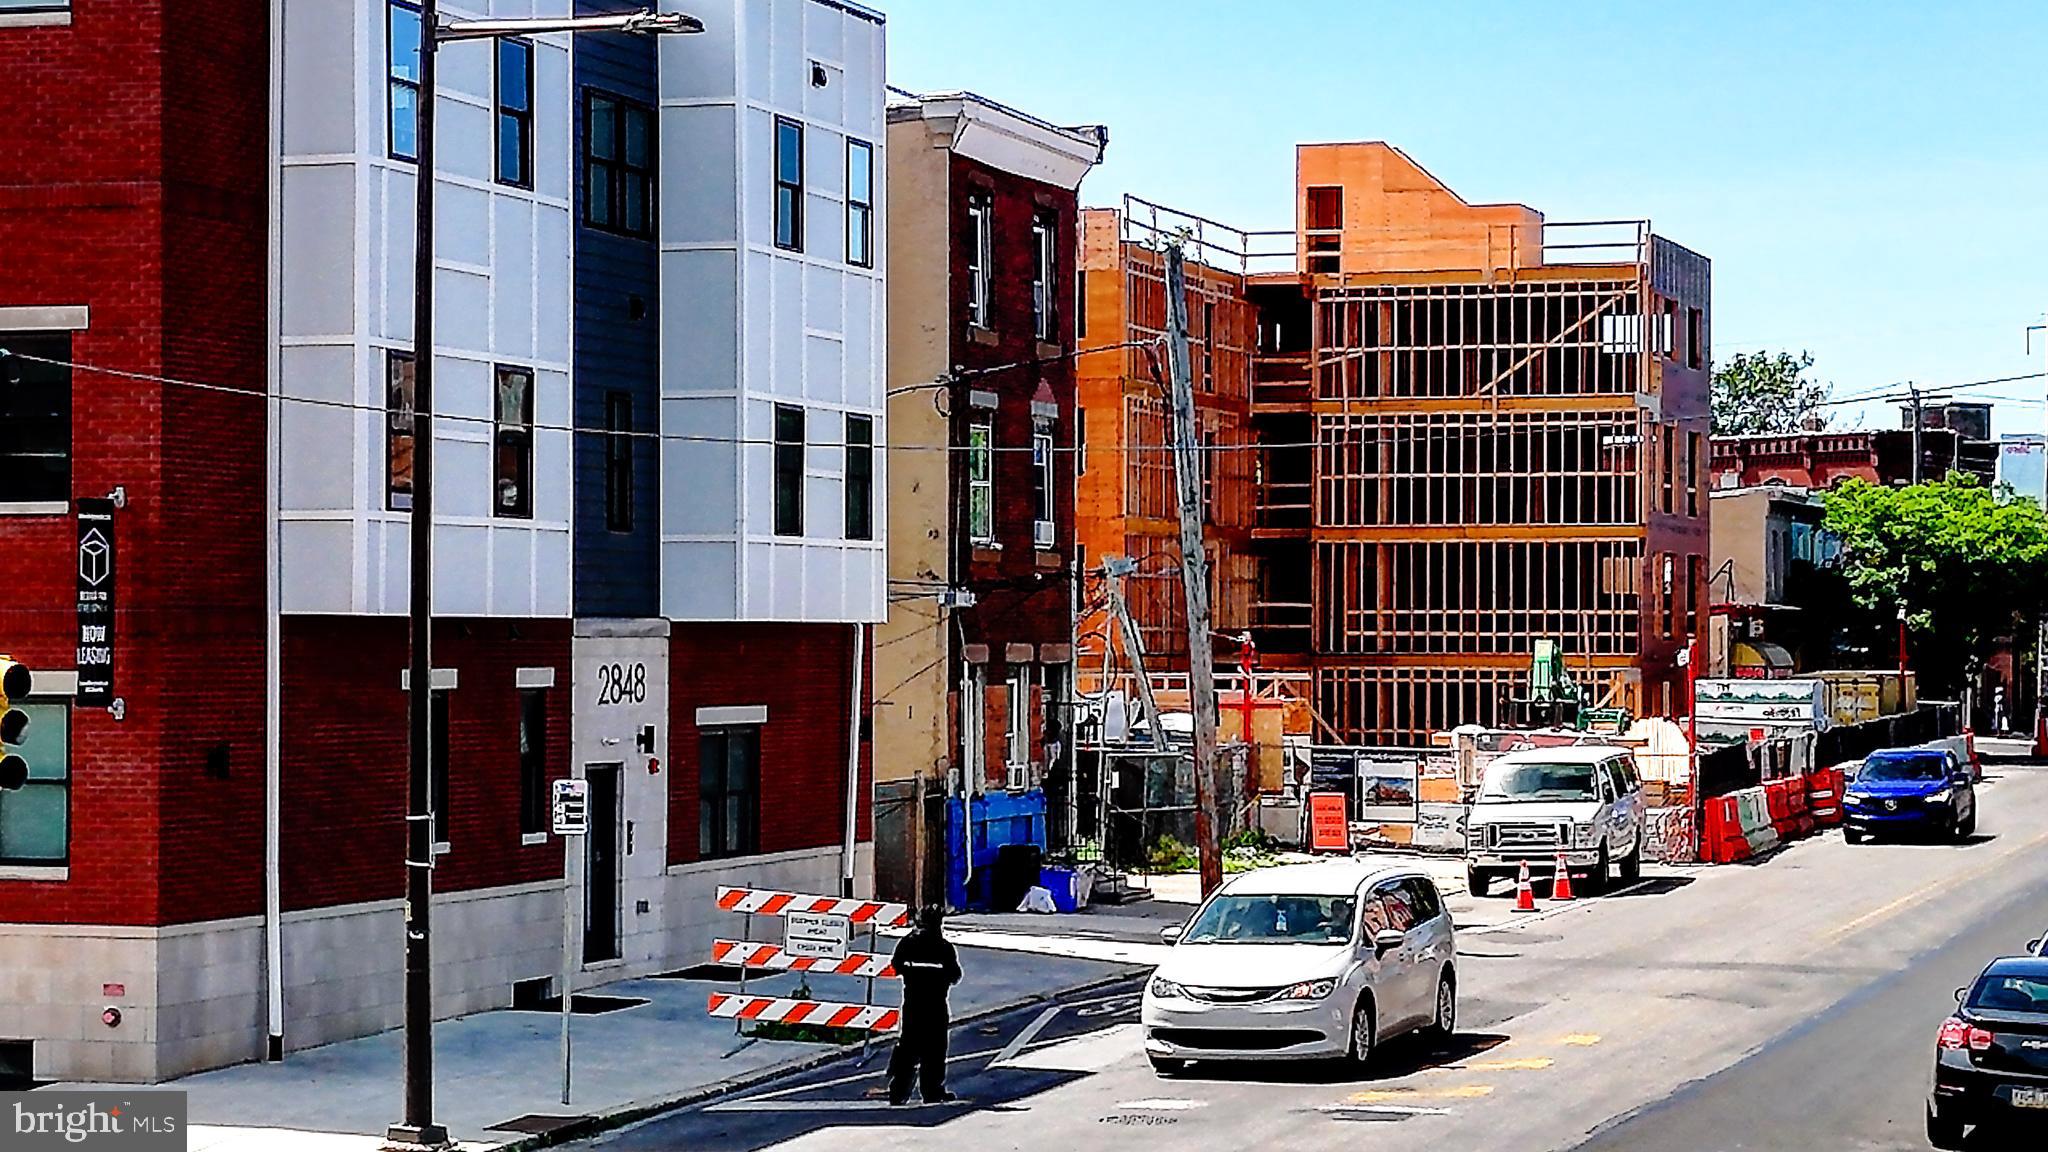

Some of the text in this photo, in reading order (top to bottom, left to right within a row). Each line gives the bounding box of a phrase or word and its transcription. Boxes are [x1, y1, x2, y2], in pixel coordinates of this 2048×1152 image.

[82, 625, 106, 643] NOW
[77, 647, 111, 665] LEASING
[598, 663, 646, 706] 2848
